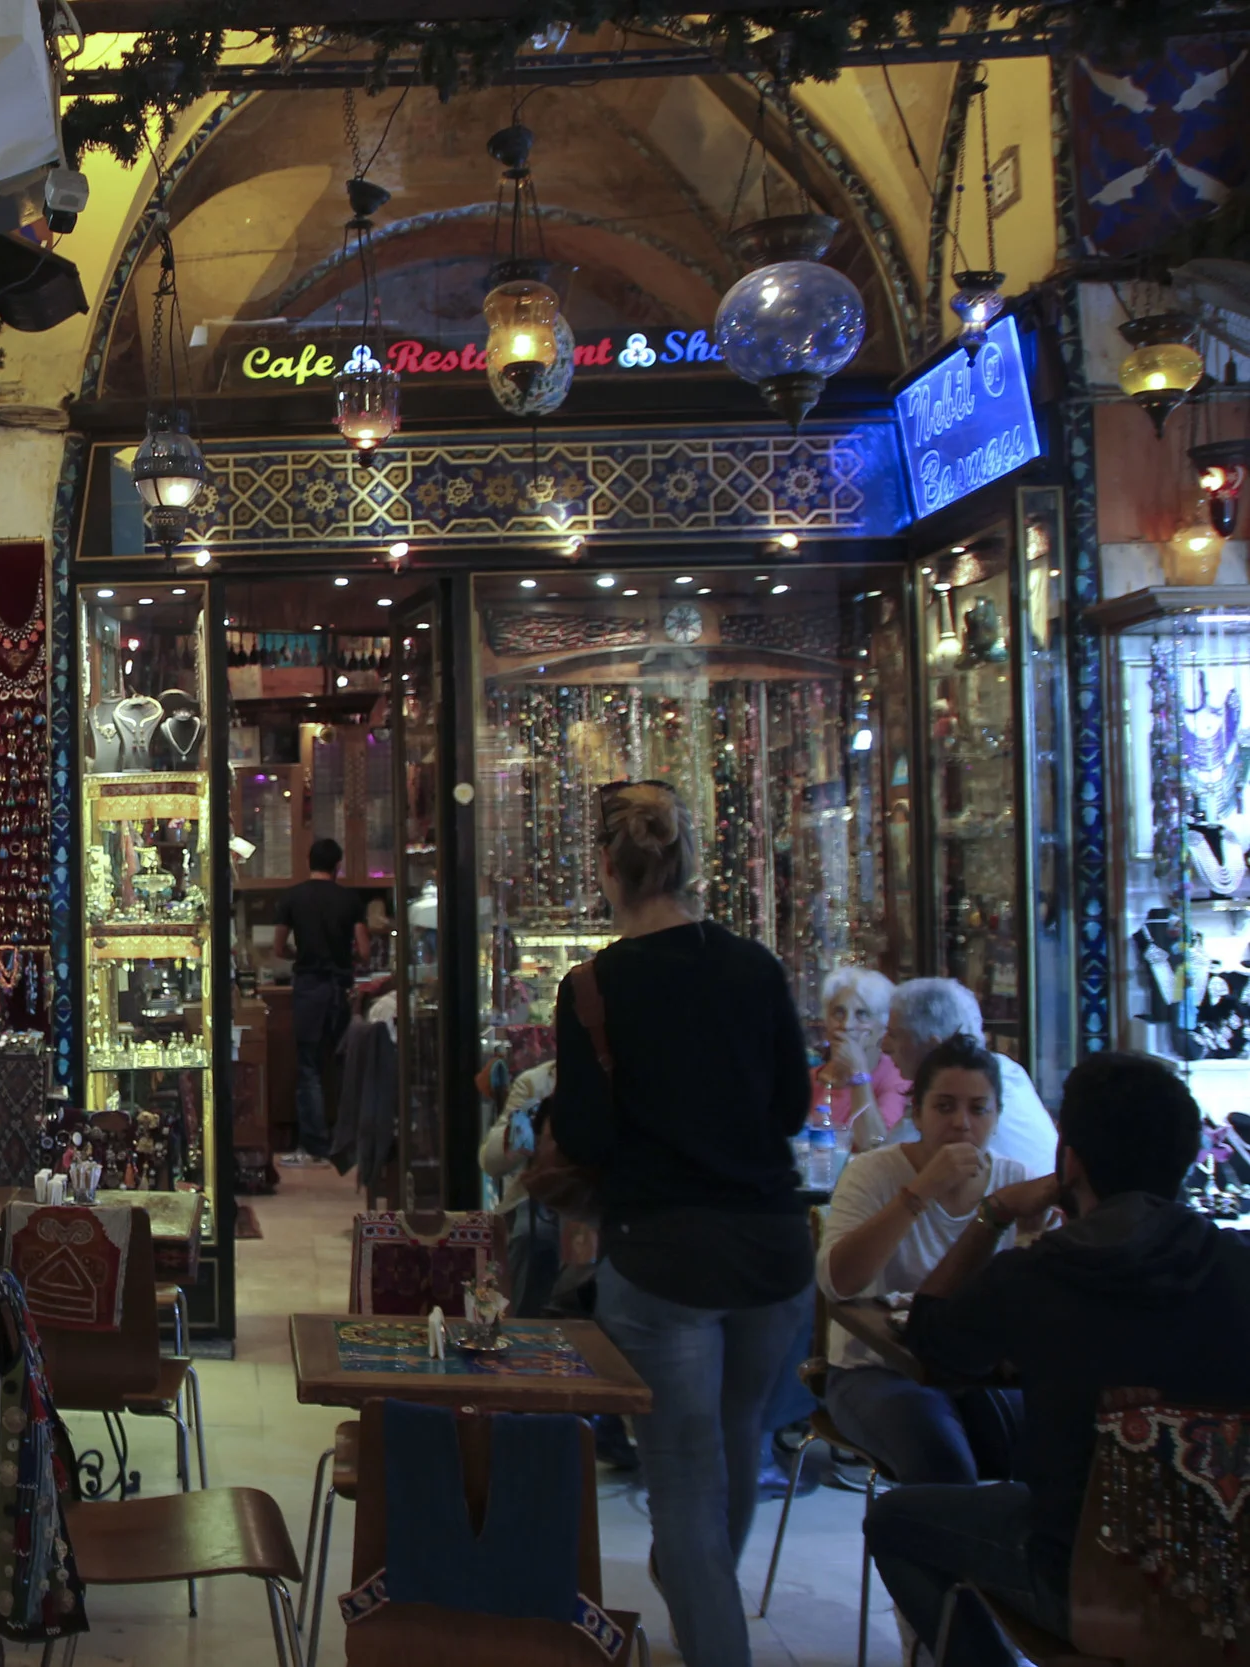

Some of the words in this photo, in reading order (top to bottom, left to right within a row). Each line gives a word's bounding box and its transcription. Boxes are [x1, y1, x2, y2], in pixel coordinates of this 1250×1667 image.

[242, 344, 336, 385] Cafe
[384, 340, 613, 373] Restant
[908, 356, 975, 447] Nebil
